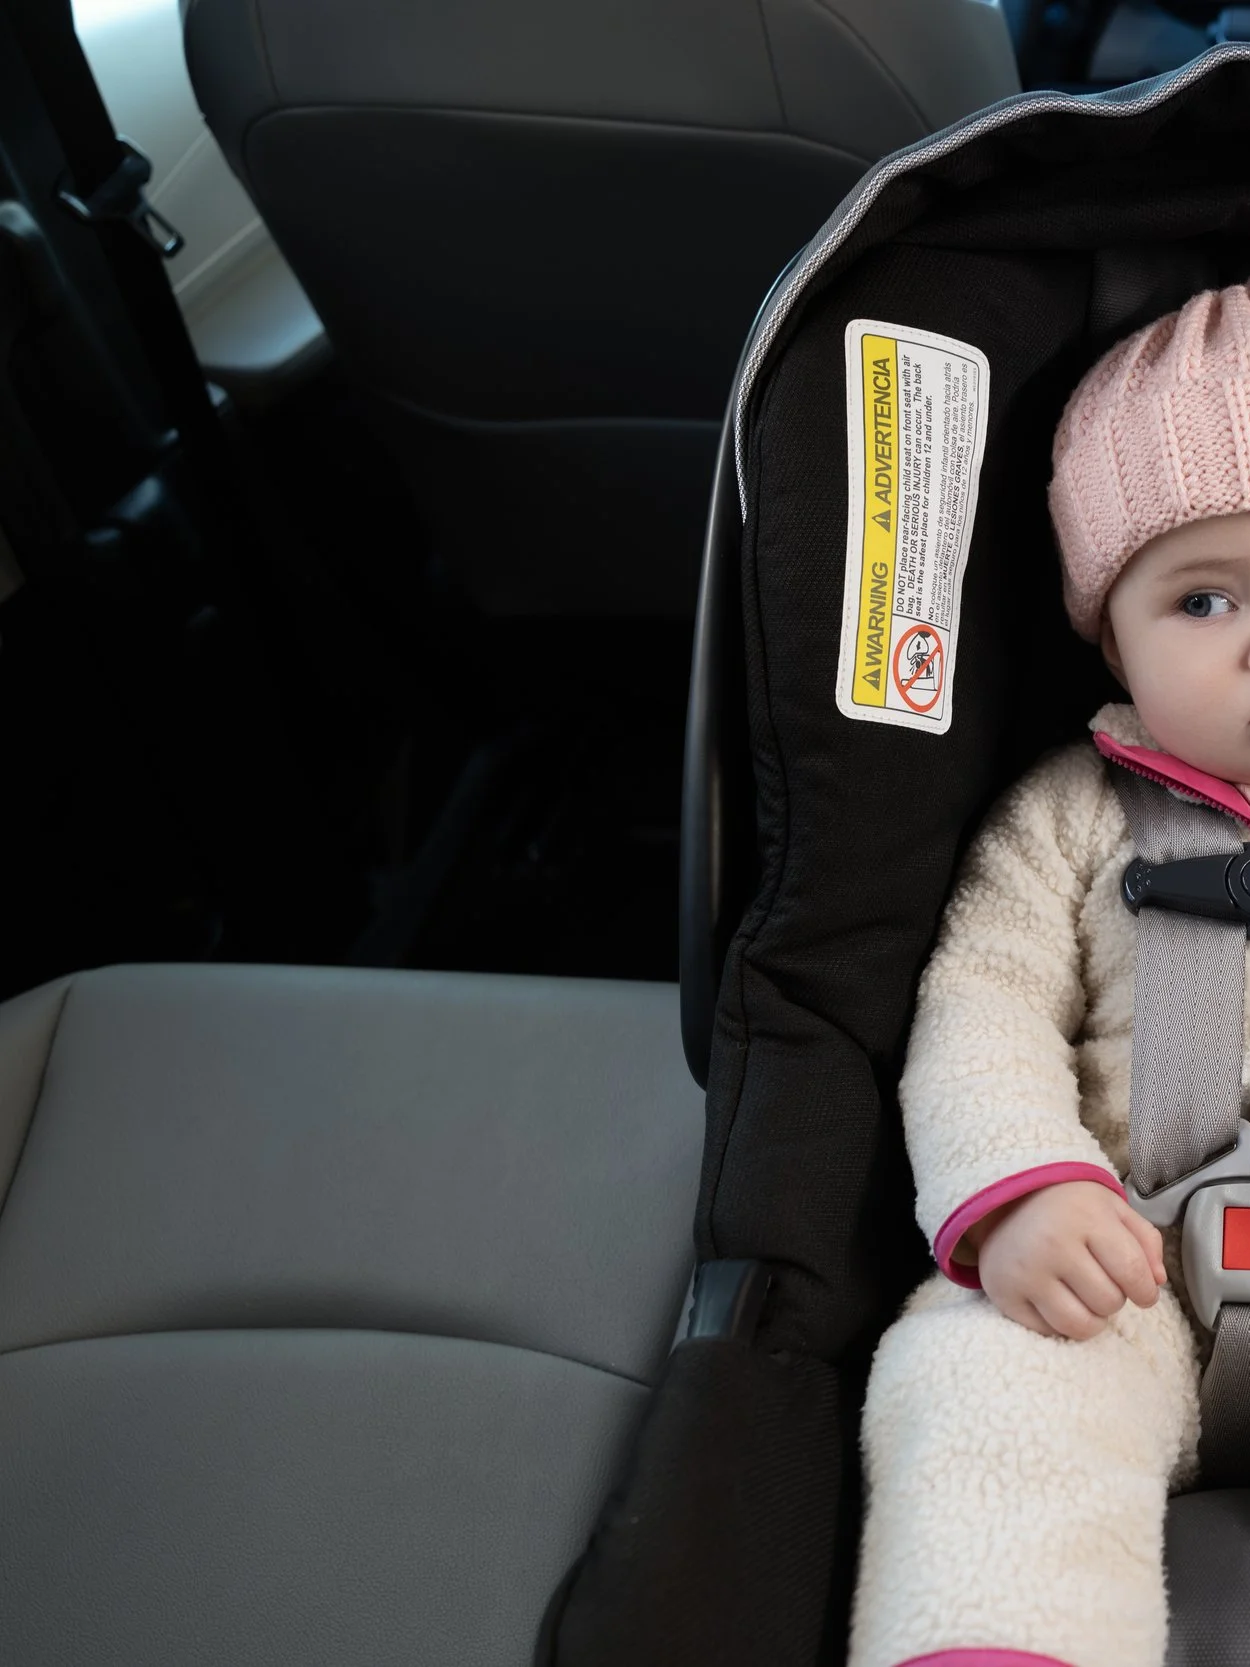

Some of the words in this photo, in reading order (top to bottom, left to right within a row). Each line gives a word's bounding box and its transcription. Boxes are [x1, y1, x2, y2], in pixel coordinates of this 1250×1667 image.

[902, 355, 910, 366] air
[902, 369, 910, 386] with
[913, 363, 921, 384] back
[913, 387, 921, 402] The
[873, 358, 891, 506] ADVERTENCIA
[903, 410, 911, 431] front
[942, 407, 950, 444] orientado
[905, 433, 911, 445] on
[924, 444, 931, 454] 12
[941, 447, 949, 472] infantil
[913, 456, 921, 491] INJURY
[923, 457, 931, 494] children
[939, 474, 947, 514] seguridad
[902, 495, 912, 544] rear-facing
[911, 493, 920, 536] SERIOUS
[937, 516, 943, 527] de
[910, 539, 917, 553] OR
[919, 539, 927, 567] safest
[900, 547, 908, 572] place
[933, 561, 938, 570] un
[908, 556, 916, 589] DEATH
[930, 573, 938, 605] coloque
[865, 562, 889, 667] WARNING
[896, 597, 904, 612] DO
[906, 595, 915, 614] bag.
[928, 607, 934, 621] NO
